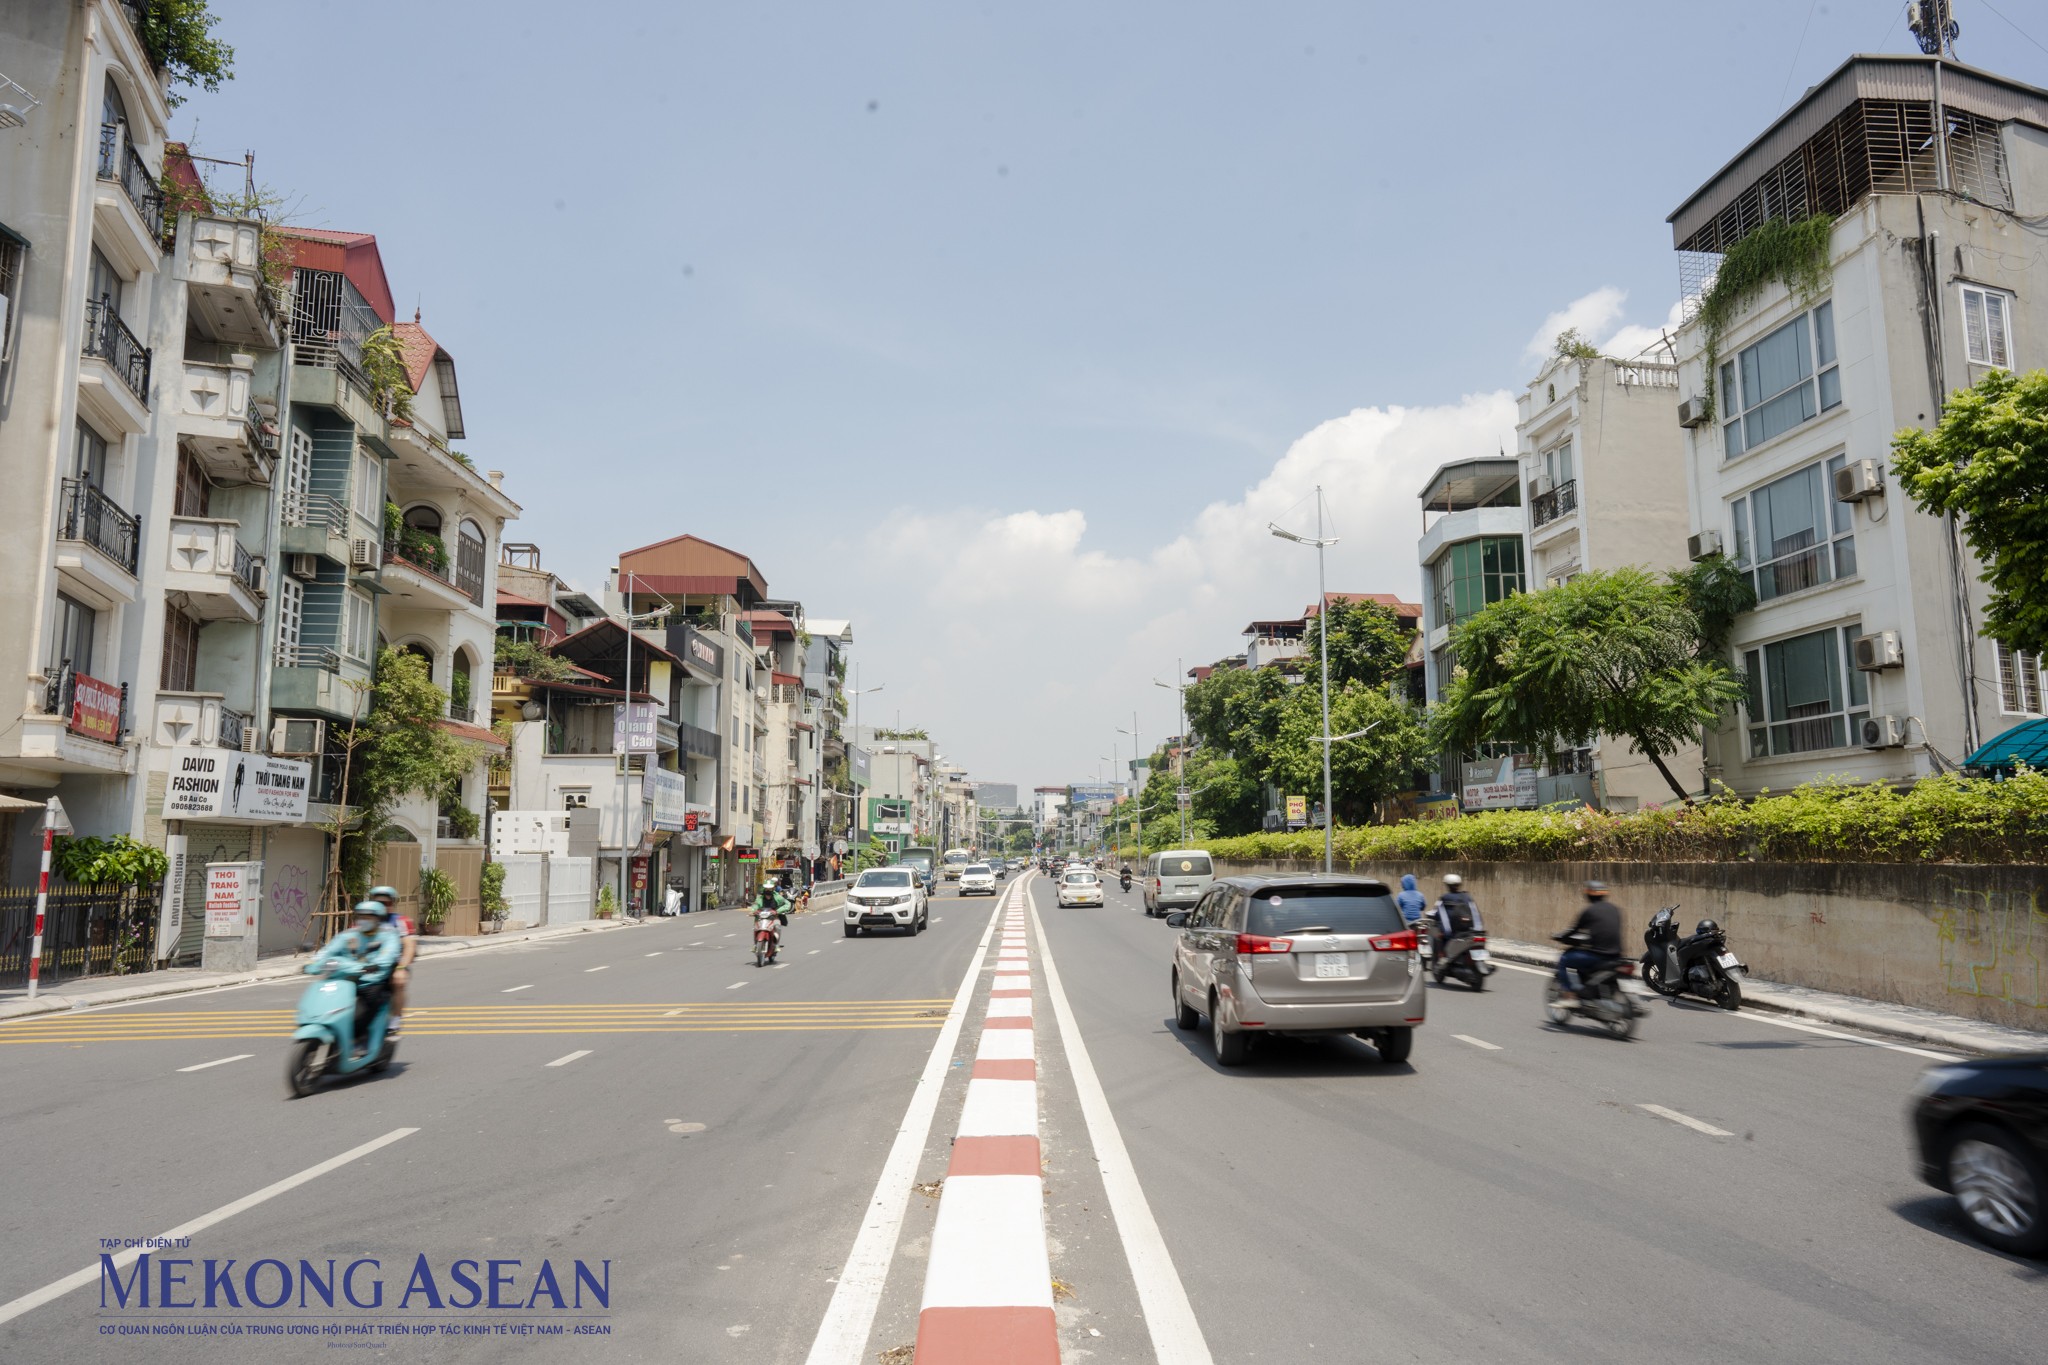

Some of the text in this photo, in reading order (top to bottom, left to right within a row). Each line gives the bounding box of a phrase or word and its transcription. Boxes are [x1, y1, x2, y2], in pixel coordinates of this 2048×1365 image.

[636, 705, 647, 718] In
[631, 734, 653, 747] Cáo
[182, 757, 215, 773] DAVID
[172, 776, 220, 793] FASHION
[271, 773, 291, 789] TRANG
[291, 776, 305, 790] NAM
[171, 853, 184, 927] DAVID FASHION
[210, 881, 239, 889] TRANG
